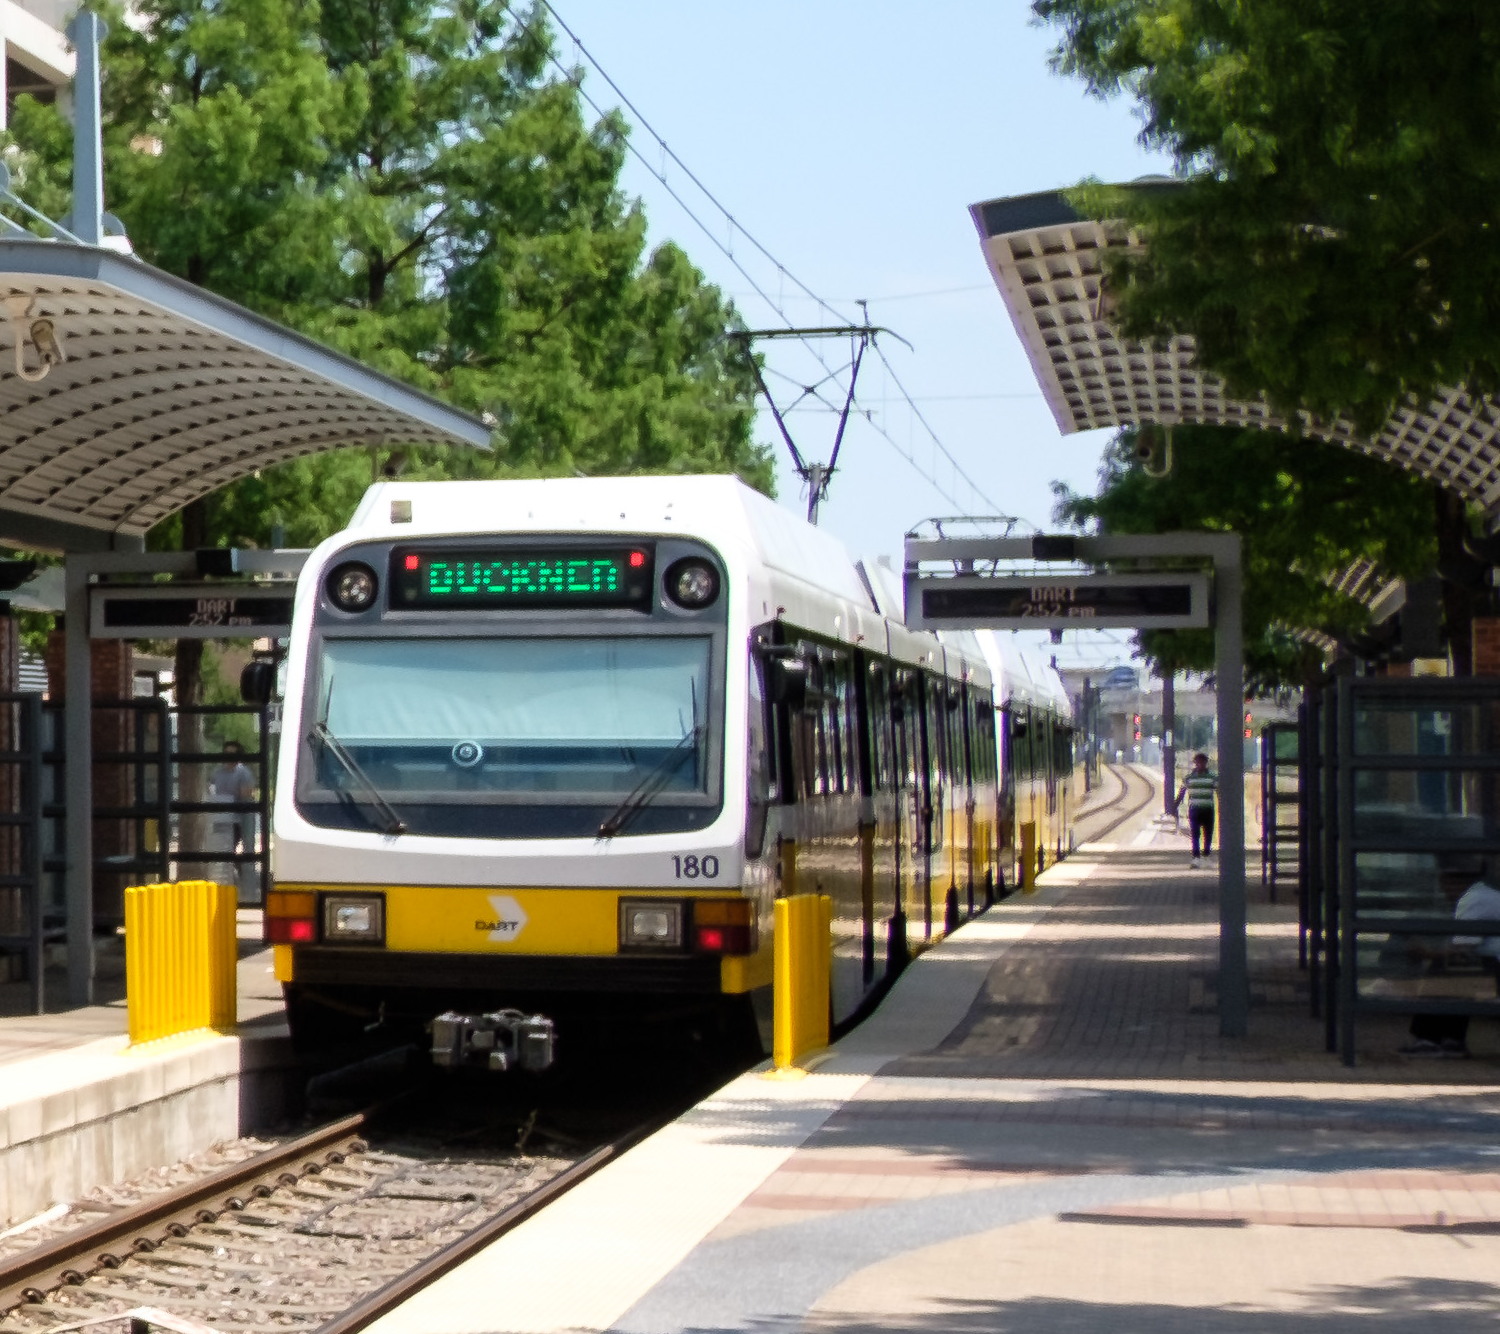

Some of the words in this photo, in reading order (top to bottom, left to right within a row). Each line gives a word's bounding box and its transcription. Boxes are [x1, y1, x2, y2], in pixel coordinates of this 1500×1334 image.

[1030, 585, 1078, 603] DART
[197, 598, 238, 614] DART
[671, 854, 720, 880] 180
[474, 920, 519, 932] DART
